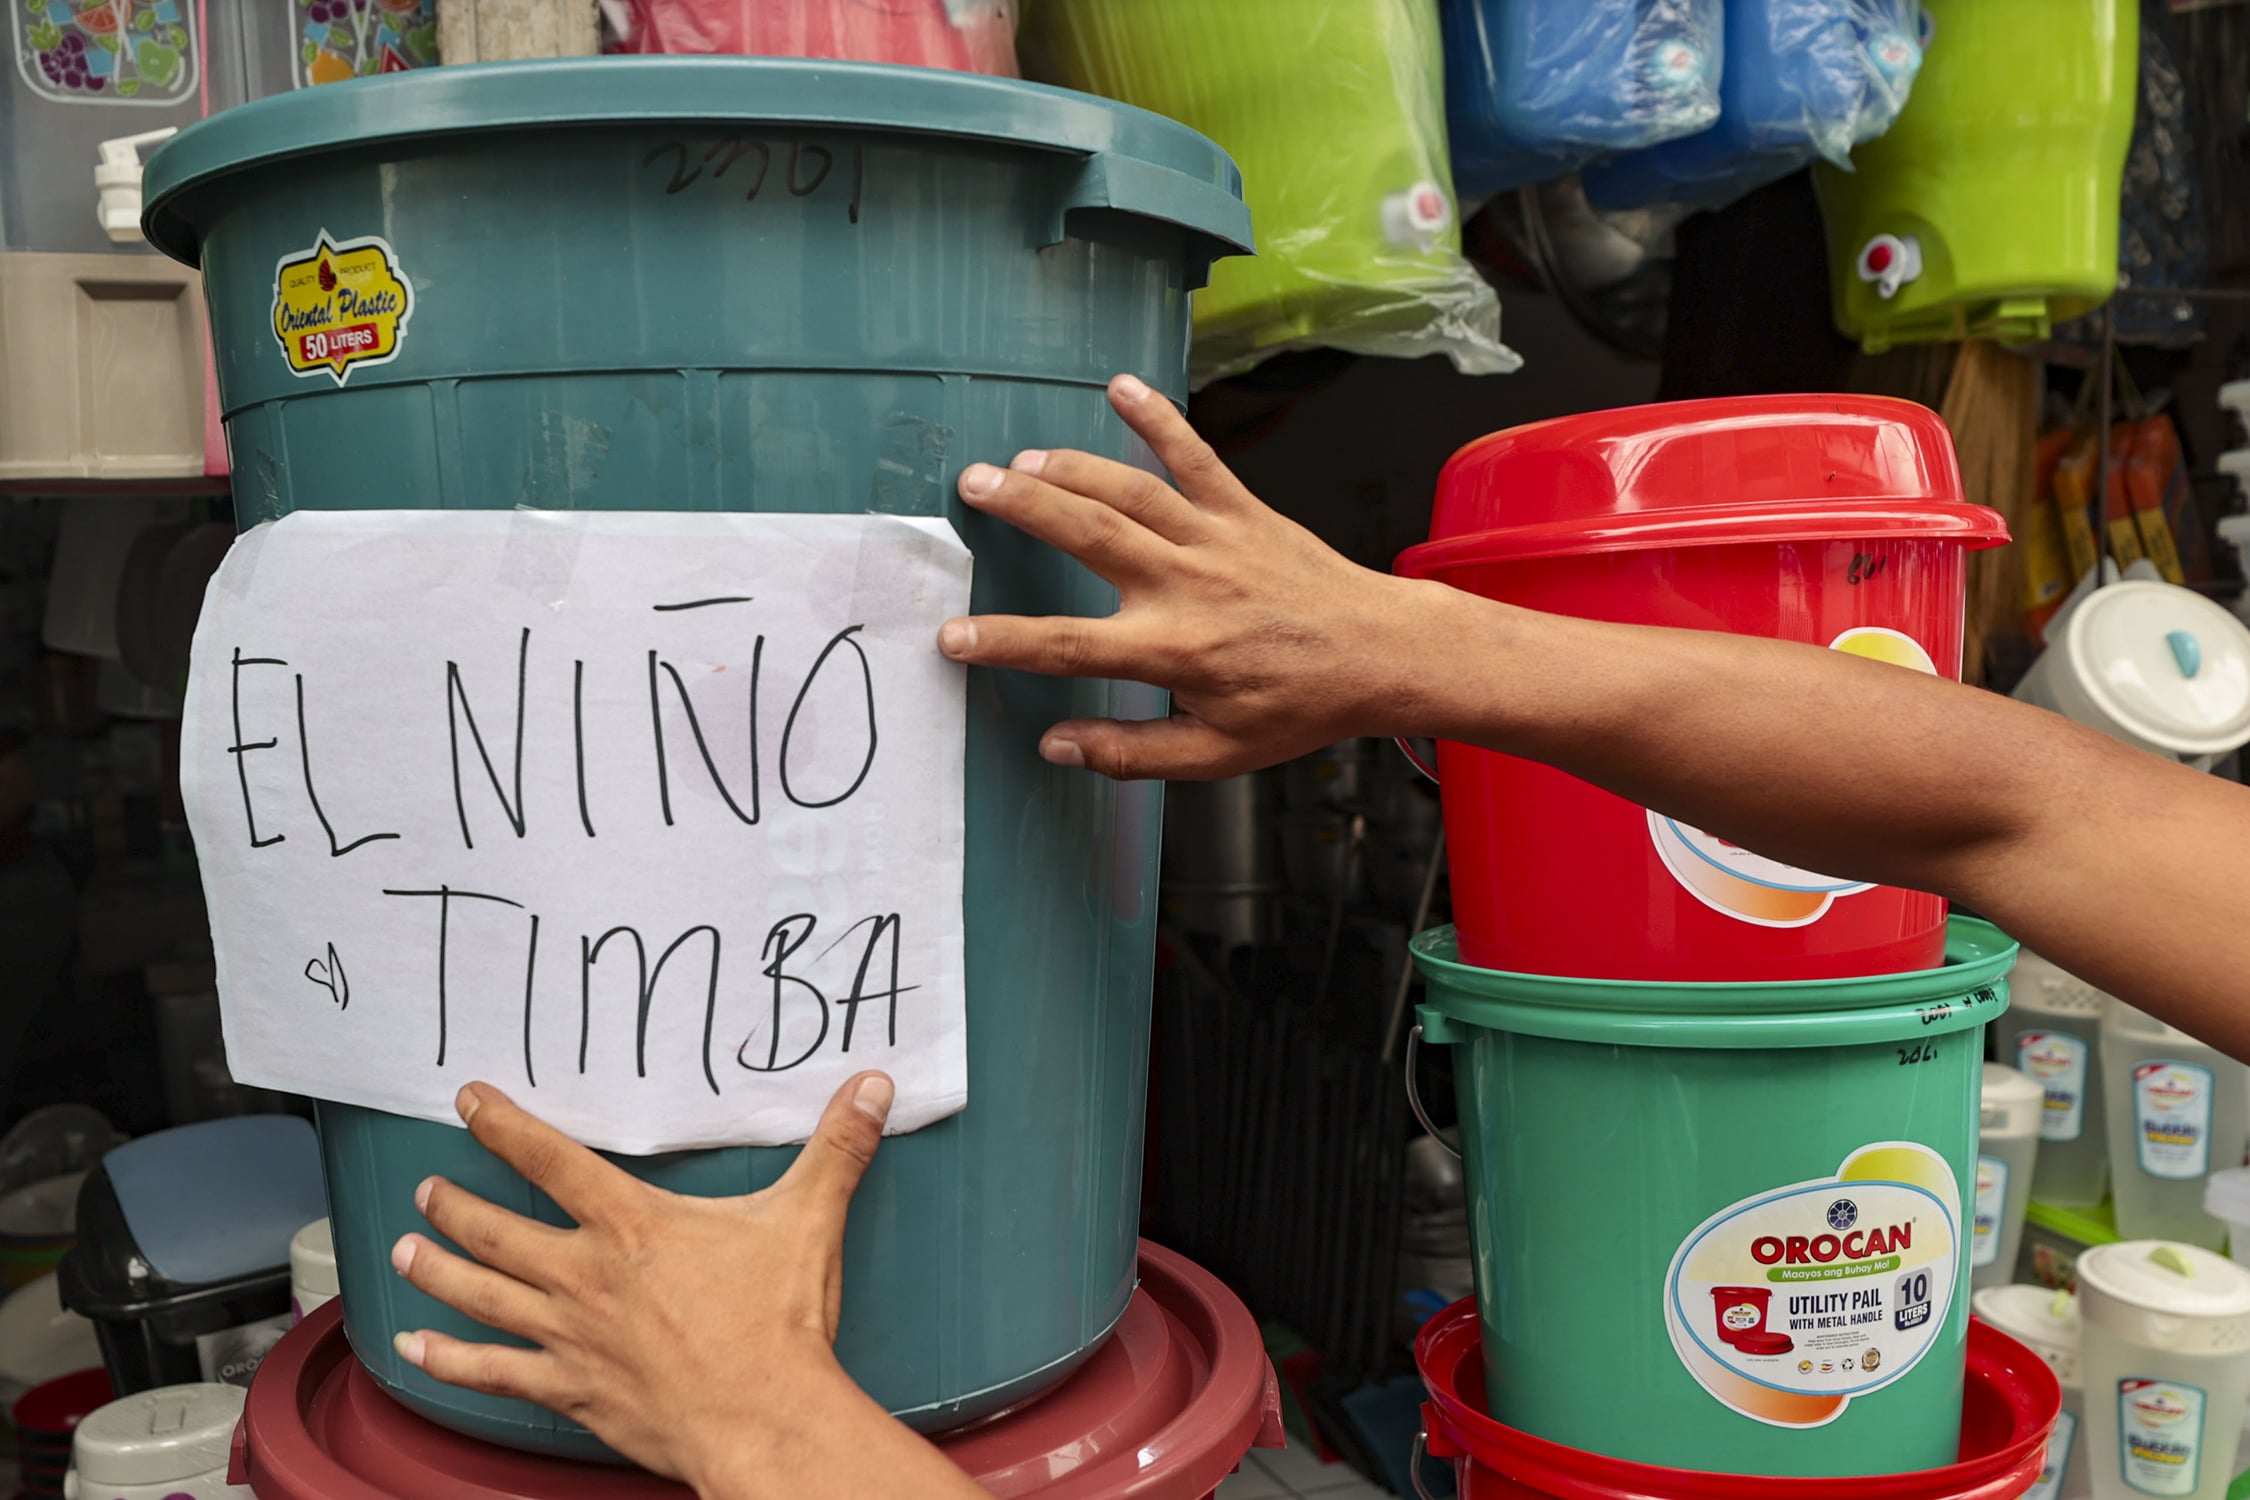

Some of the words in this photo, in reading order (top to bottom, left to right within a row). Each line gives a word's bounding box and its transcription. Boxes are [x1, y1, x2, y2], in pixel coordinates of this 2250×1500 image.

[289, 274, 315, 288] QUALITY
[339, 261, 376, 275] PRODUCT
[281, 296, 332, 332] Oriental
[337, 288, 398, 322] Plastic
[305, 333, 328, 360] 50
[330, 329, 373, 350] LITERS
[228, 647, 400, 857] EL
[448, 596, 878, 849] NIÑO
[382, 884, 923, 1096] TIMBA
[1750, 1222, 1912, 1265] OROCAN
[1782, 1269, 1822, 1280] Maayos
[1824, 1266, 1843, 1277] ang
[1845, 1264, 1872, 1275] Buhay
[1874, 1260, 1890, 1270] Mo!
[1789, 1292, 1848, 1315] UTILITY
[1852, 1288, 1882, 1310] PAIL
[1901, 1273, 1927, 1306] 10
[1789, 1318, 1814, 1330] WITH
[1817, 1315, 1847, 1329] METAL
[1850, 1310, 1883, 1325] HANDLE
[1899, 1303, 1928, 1322] LITERS
